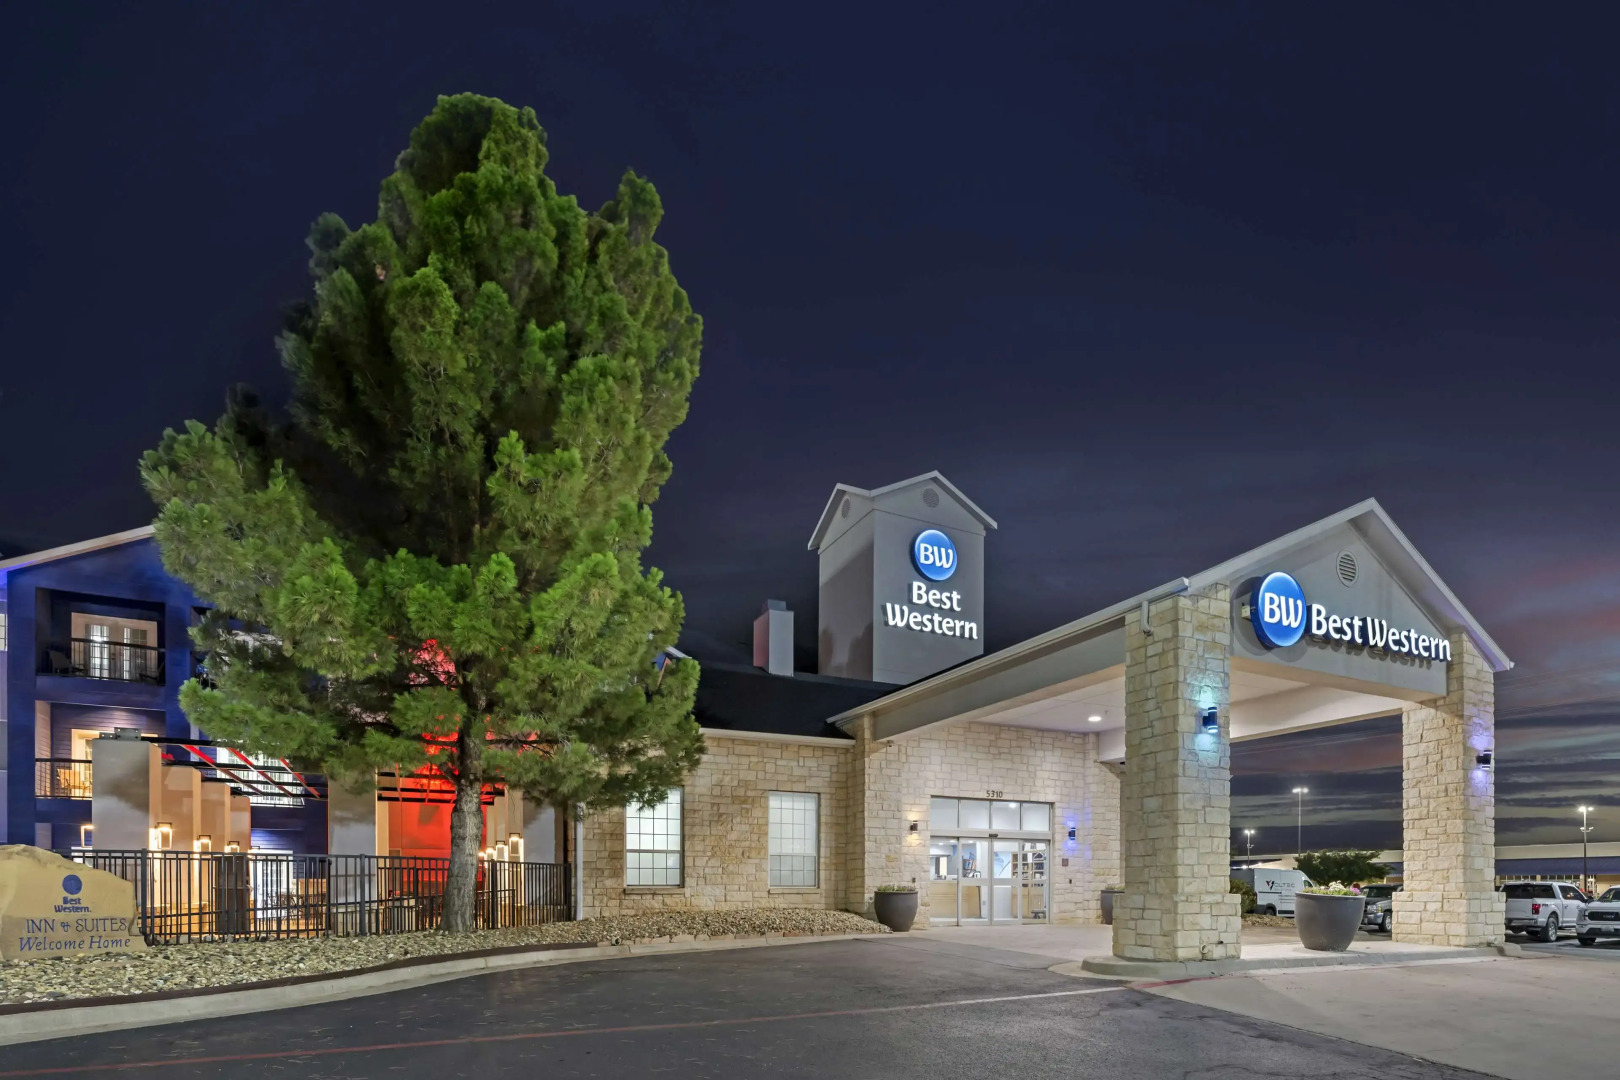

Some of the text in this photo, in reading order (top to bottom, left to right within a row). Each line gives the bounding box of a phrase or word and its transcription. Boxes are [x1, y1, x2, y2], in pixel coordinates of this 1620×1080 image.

[920, 543, 953, 569] BW
[912, 581, 961, 611] Best
[1264, 592, 1302, 628] BW
[886, 602, 978, 639] Western
[1311, 604, 1451, 661] Best Western
[986, 790, 1003, 798] 5310
[26, 919, 55, 934] INN
[75, 918, 127, 932] SUITES
[19, 935, 131, 951] Welcome Home
